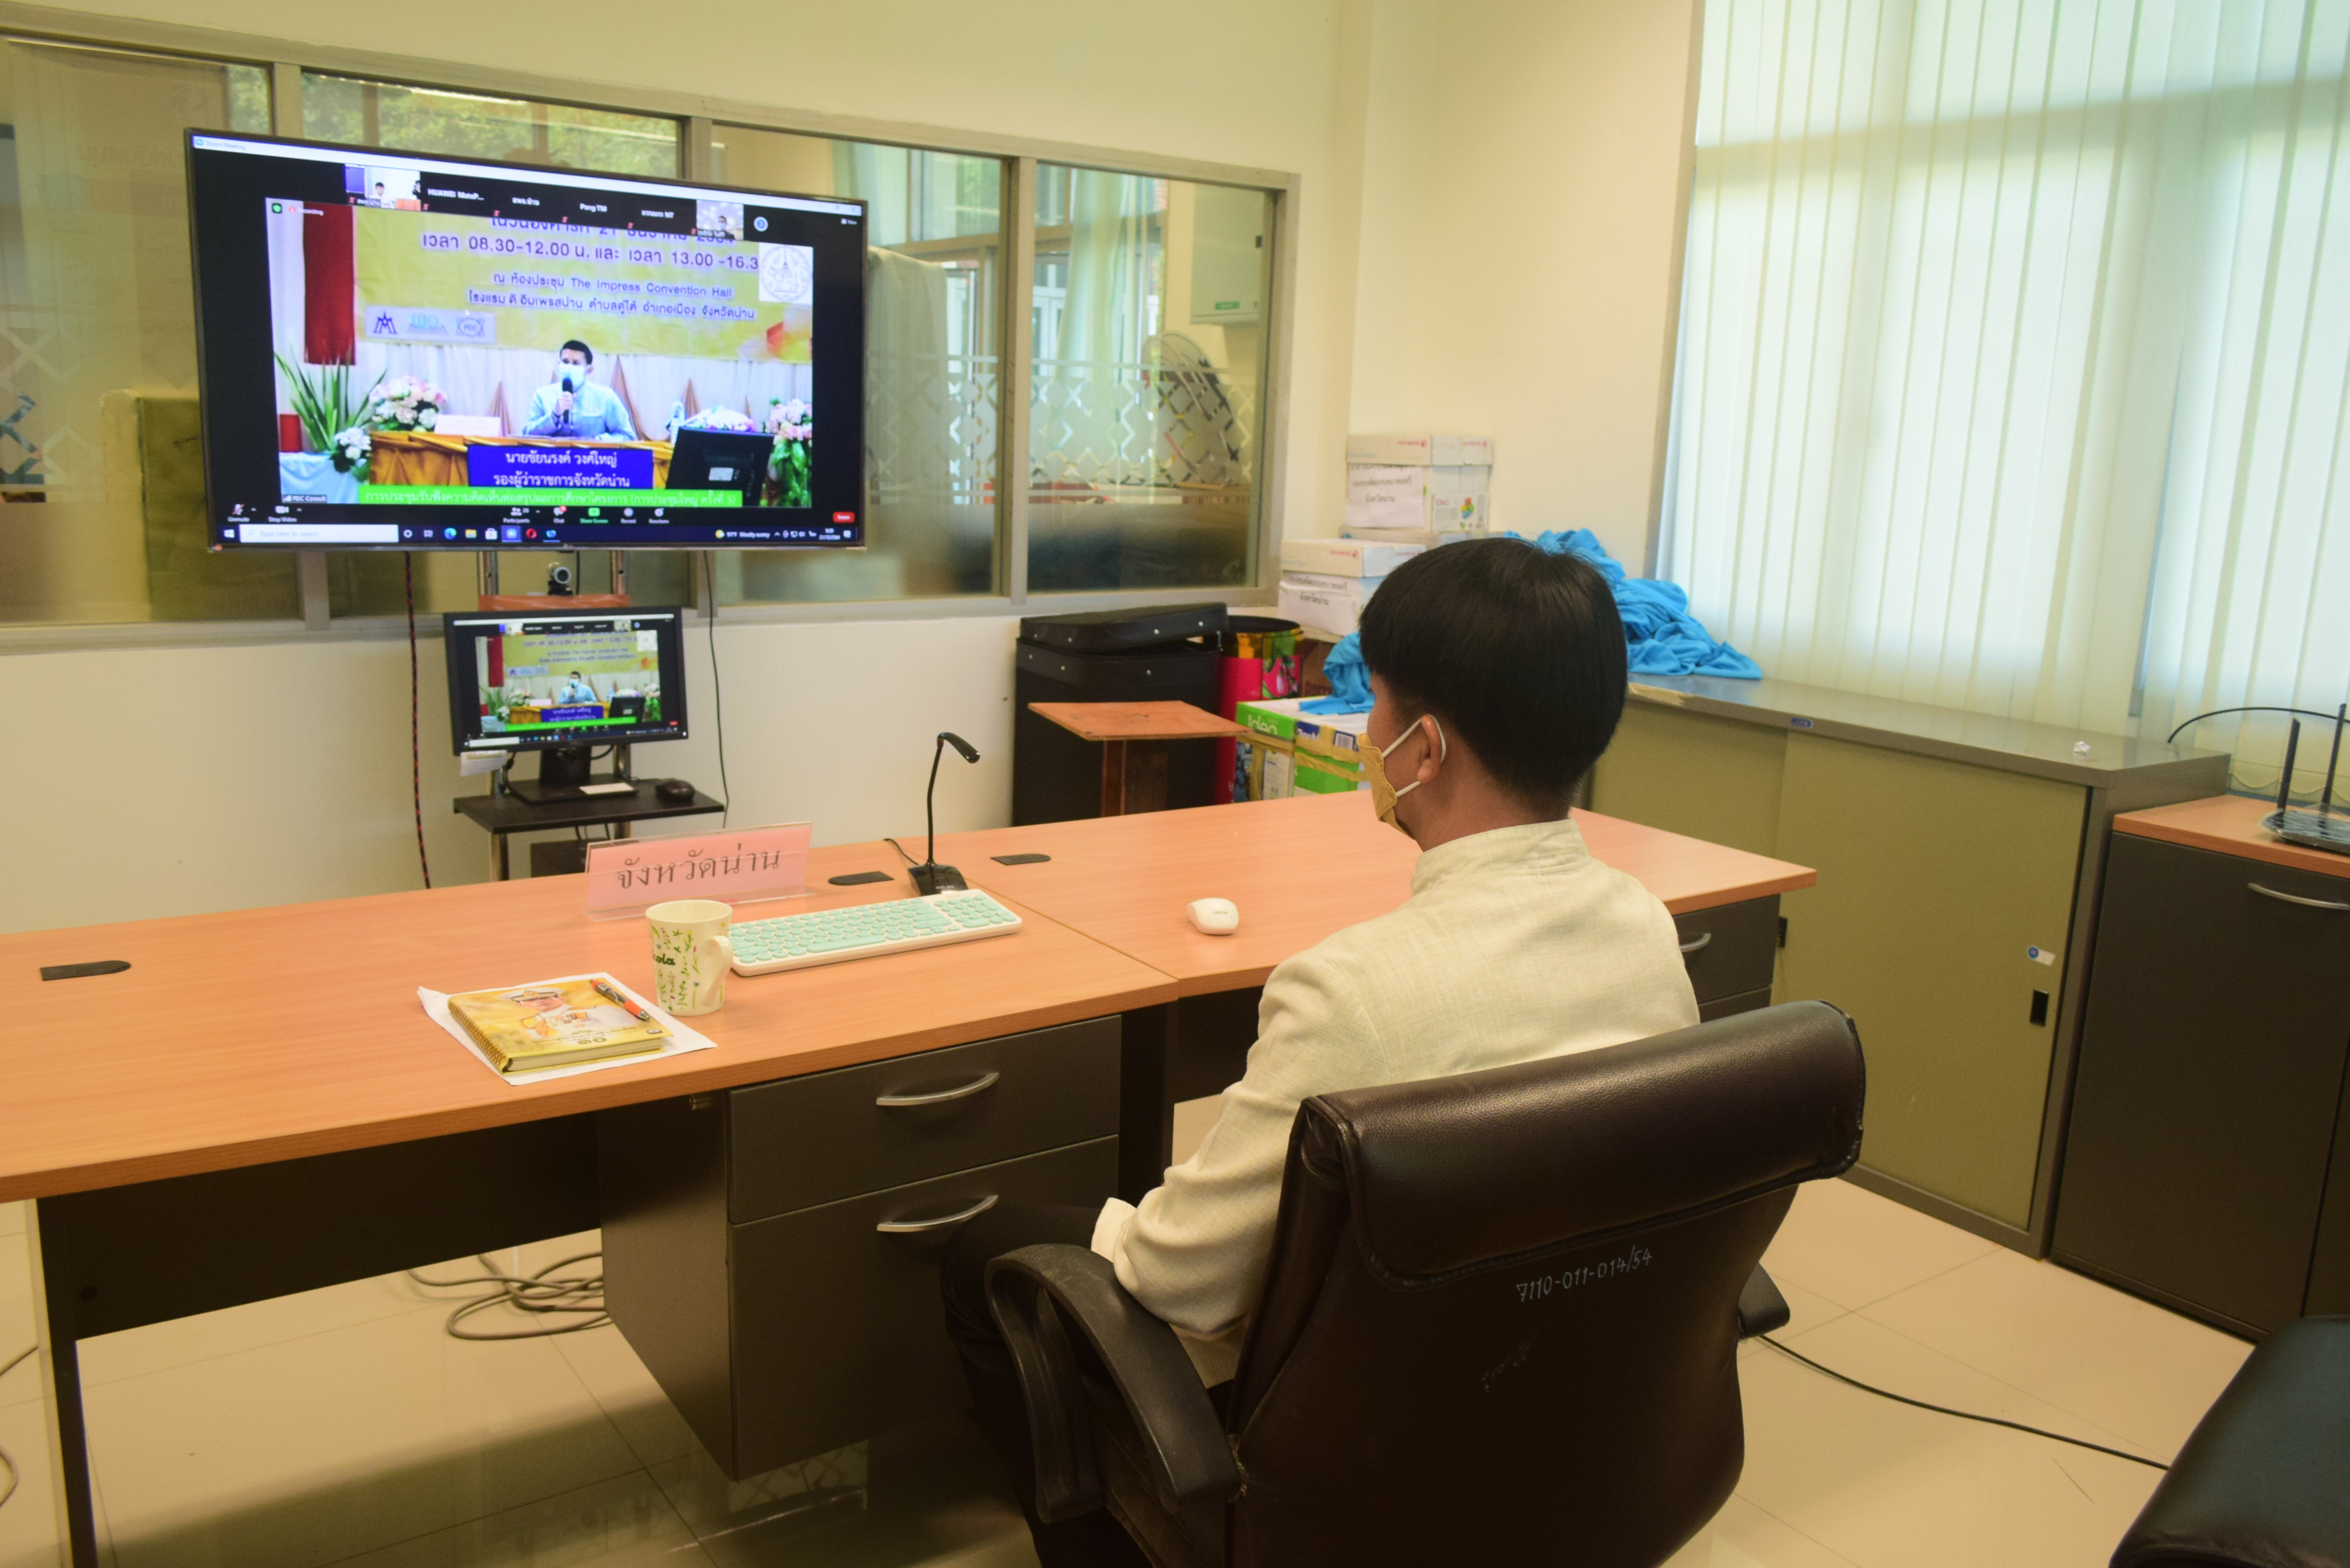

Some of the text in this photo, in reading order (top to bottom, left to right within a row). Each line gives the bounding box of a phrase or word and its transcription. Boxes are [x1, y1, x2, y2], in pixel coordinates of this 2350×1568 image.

[422, 234, 459, 249] เวลา
[468, 236, 570, 257] 08.30-12.00
[595, 247, 620, 260] และ
[629, 249, 662, 263] เวลา
[672, 252, 713, 267] 13.00
[493, 272, 732, 297] ณ ห้องประชุม The Impress Convention Hall
[701, 306, 755, 319] จังหวัดน่าน
[617, 843, 780, 889] จังหวัดน่าน
[1516, 1244, 1653, 1302] 7110-011-014/54
